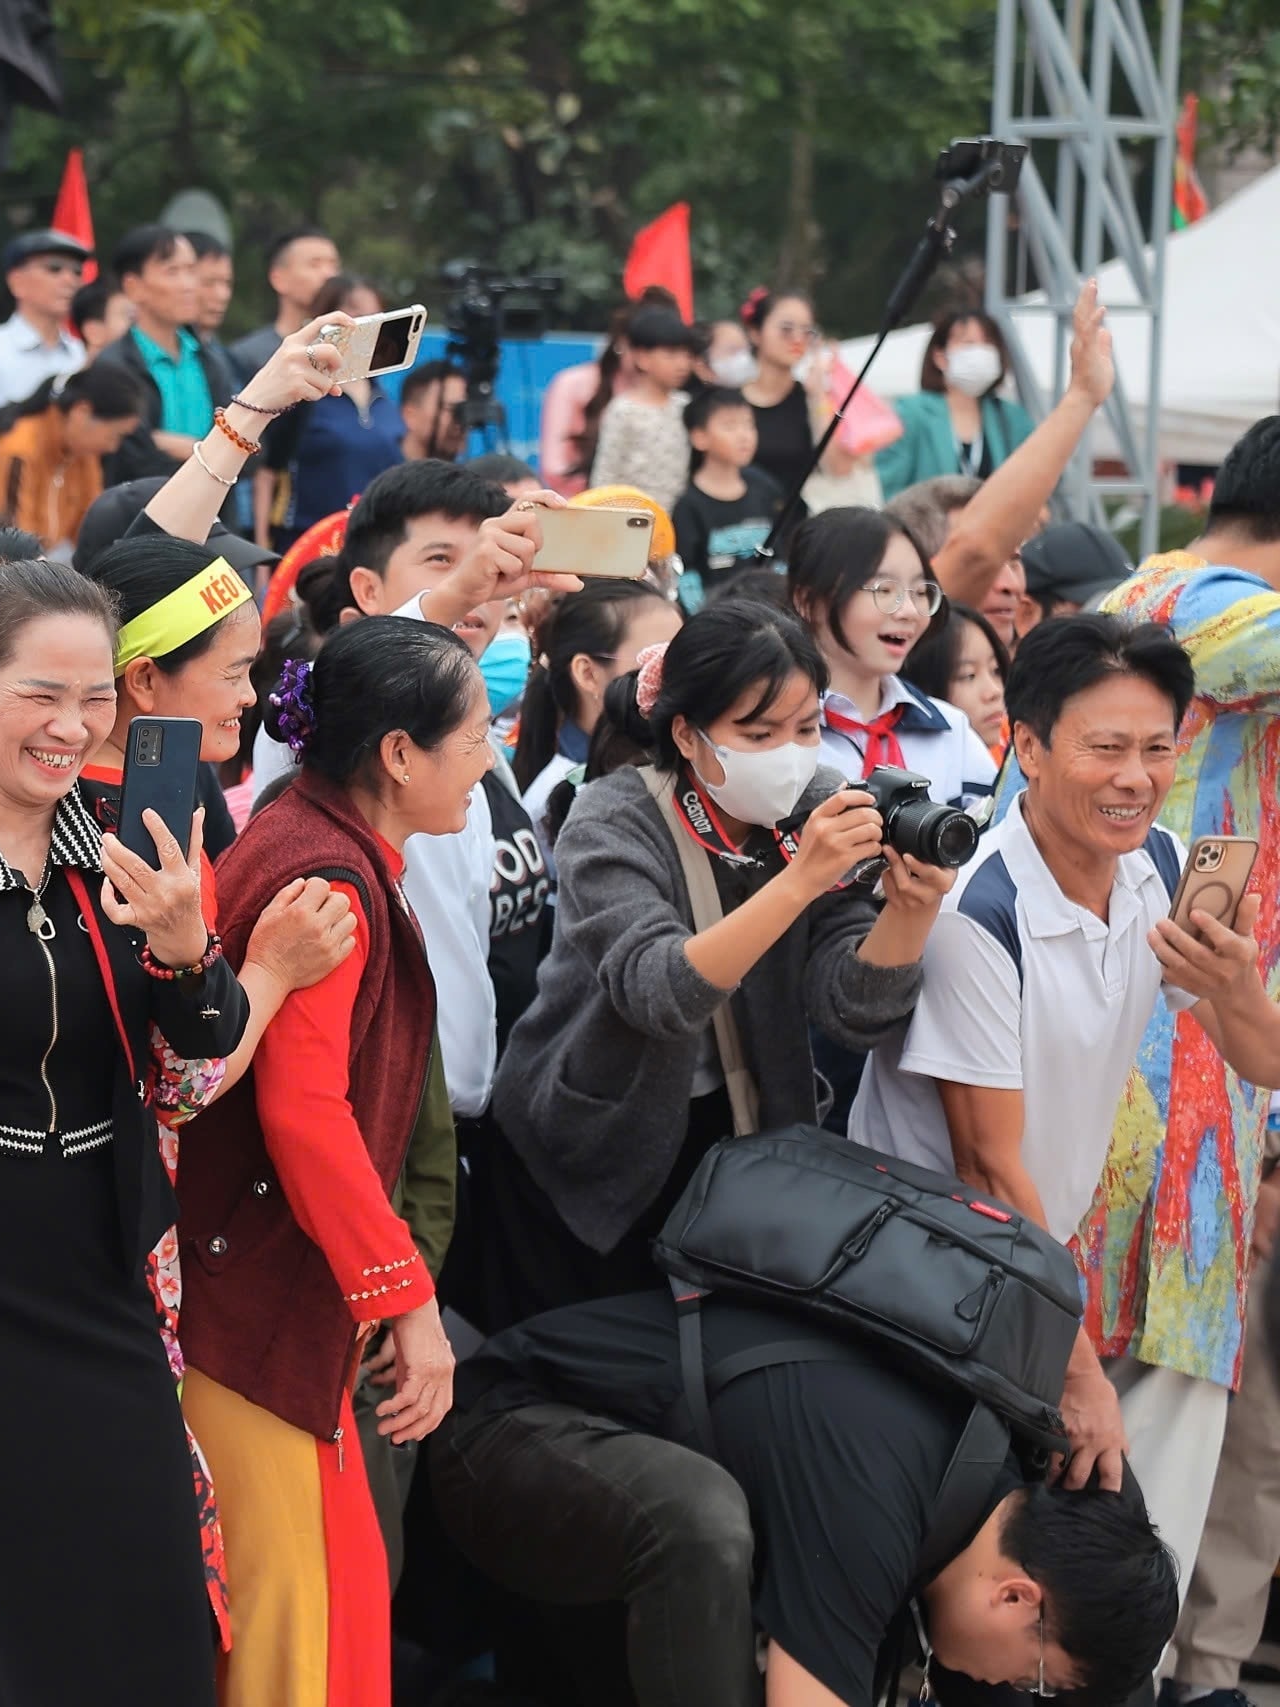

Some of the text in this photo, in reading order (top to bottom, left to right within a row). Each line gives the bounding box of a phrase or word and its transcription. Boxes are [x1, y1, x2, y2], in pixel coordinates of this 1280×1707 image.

[199, 574, 239, 615] KÉO
[682, 790, 713, 834] Canon
[490, 828, 545, 892] OD
[490, 878, 550, 937] BES
